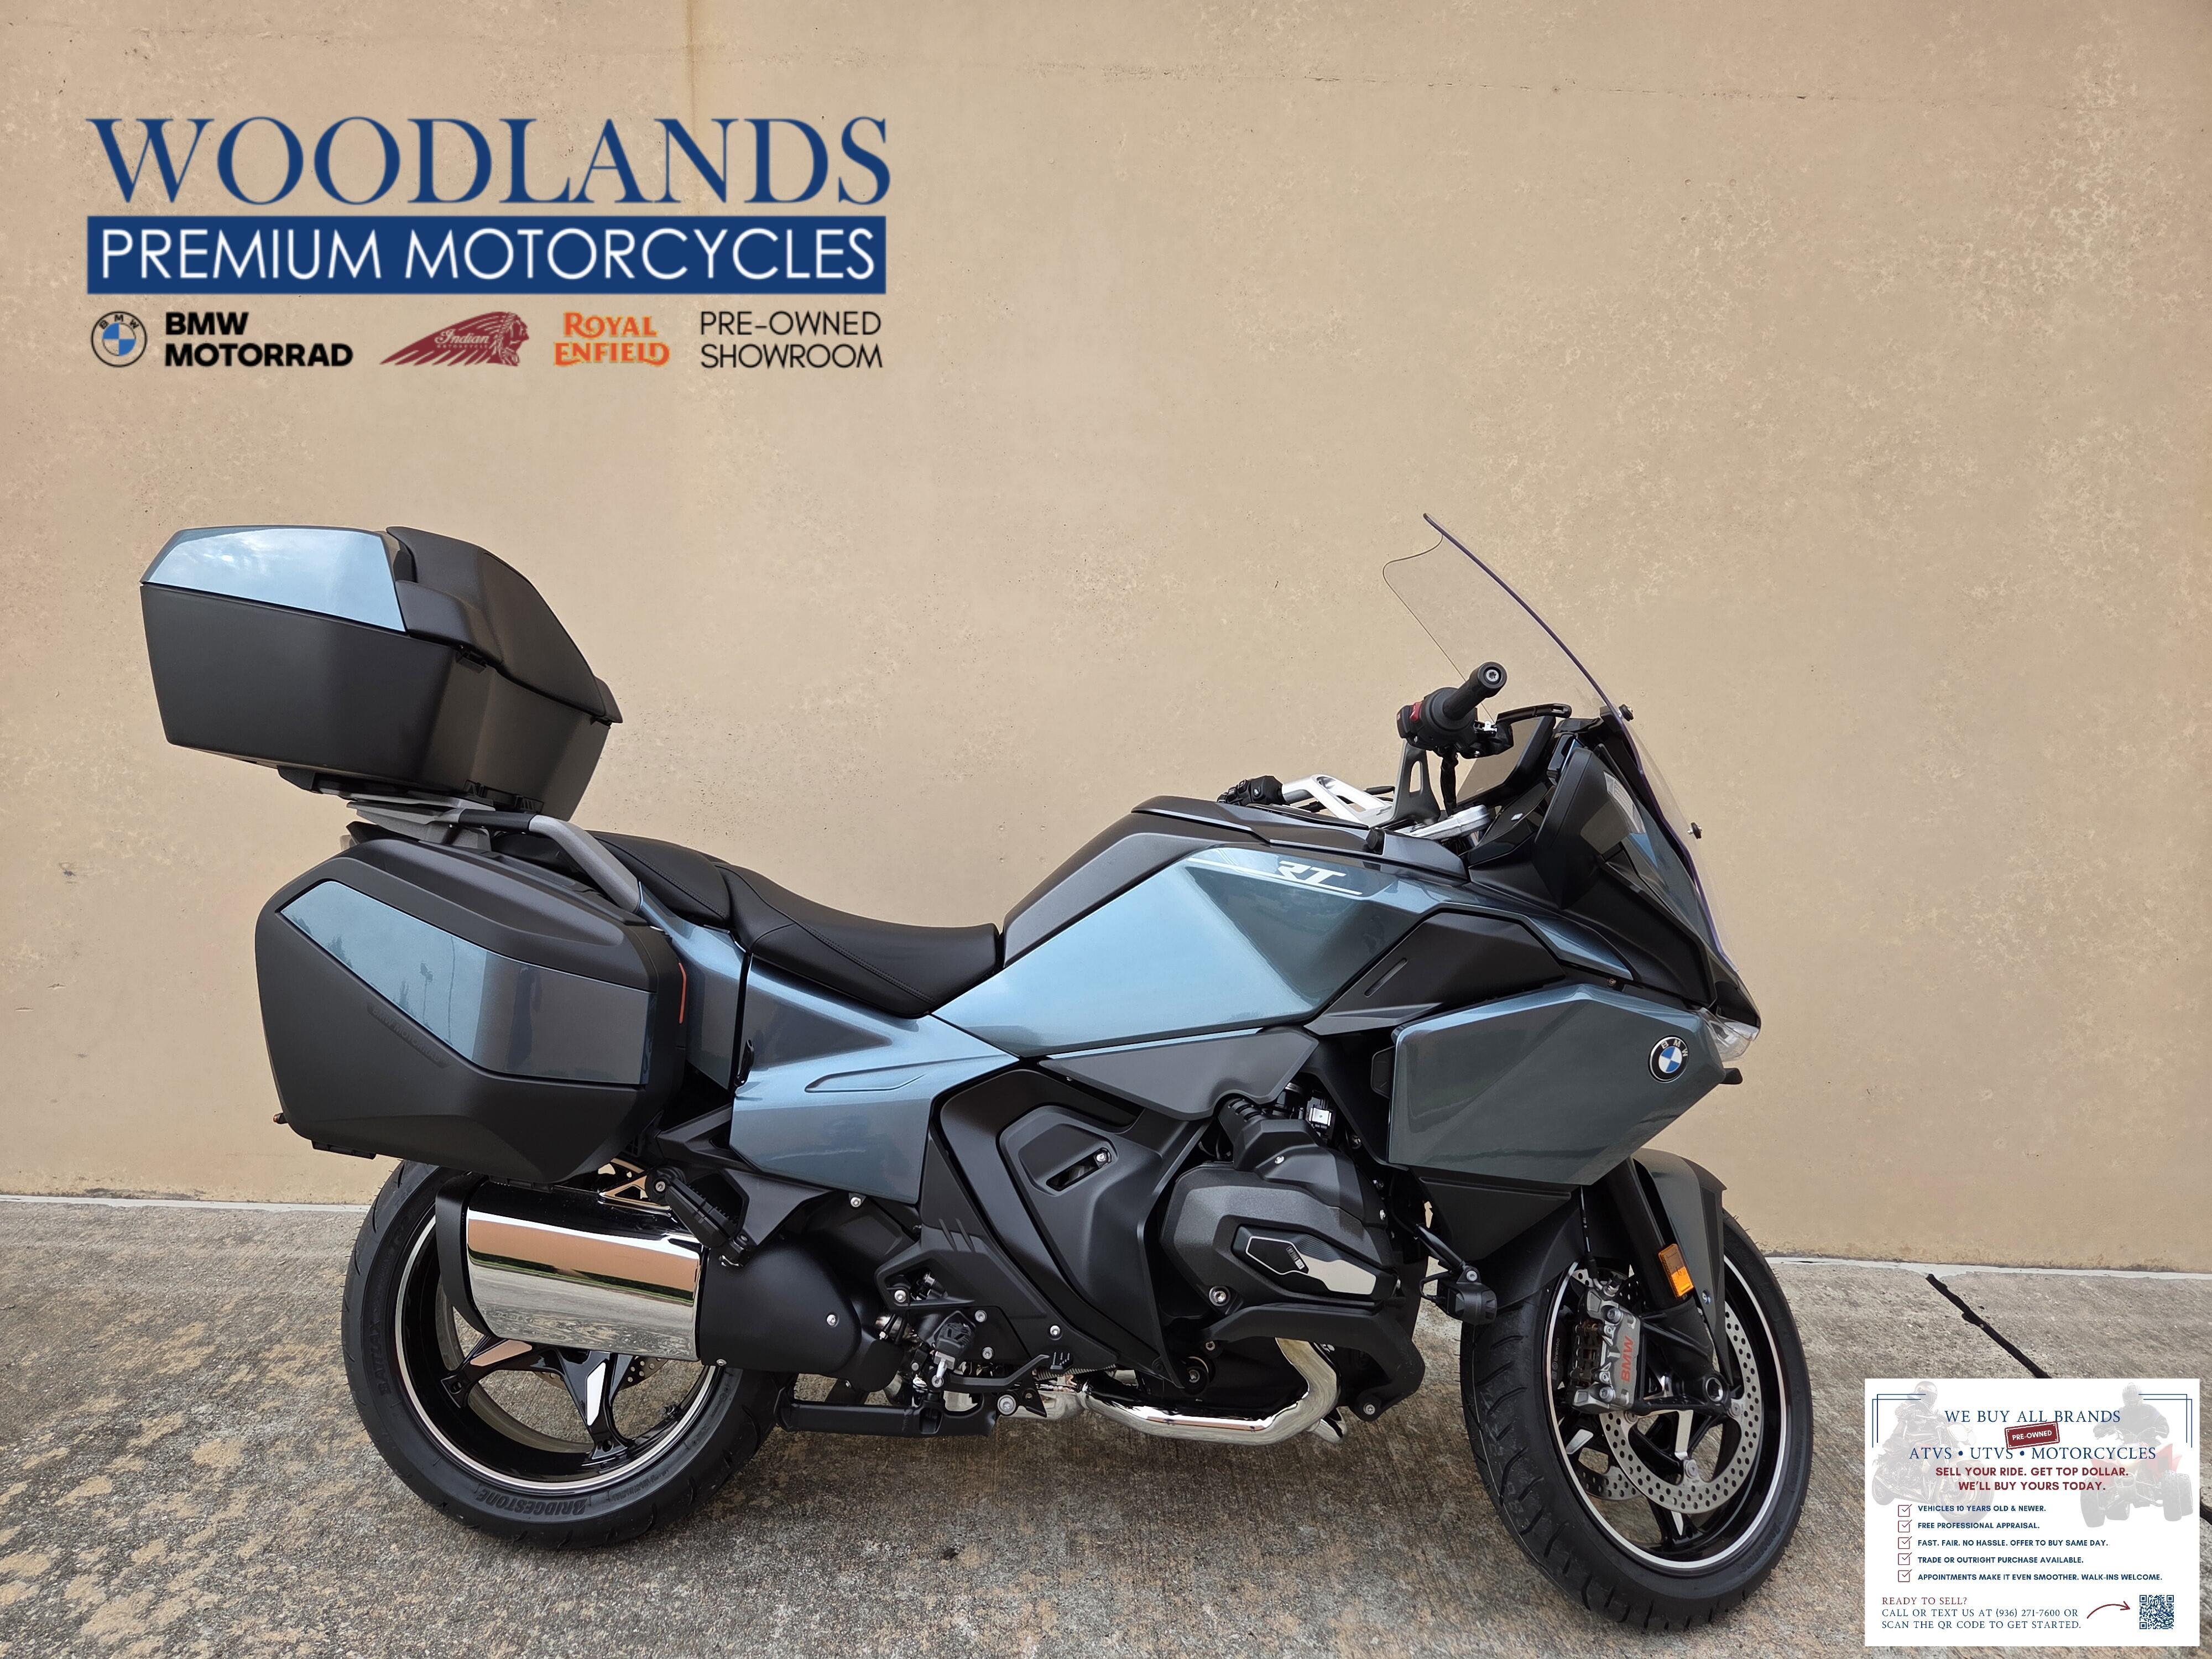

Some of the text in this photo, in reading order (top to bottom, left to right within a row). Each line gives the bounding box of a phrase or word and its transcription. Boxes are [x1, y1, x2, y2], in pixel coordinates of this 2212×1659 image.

[1277, 860, 1347, 884] RT
[1661, 1039, 1688, 1057] BMW
[1621, 1335, 1634, 1383] BMW
[470, 1491, 588, 1516] BRIDGESTONE
